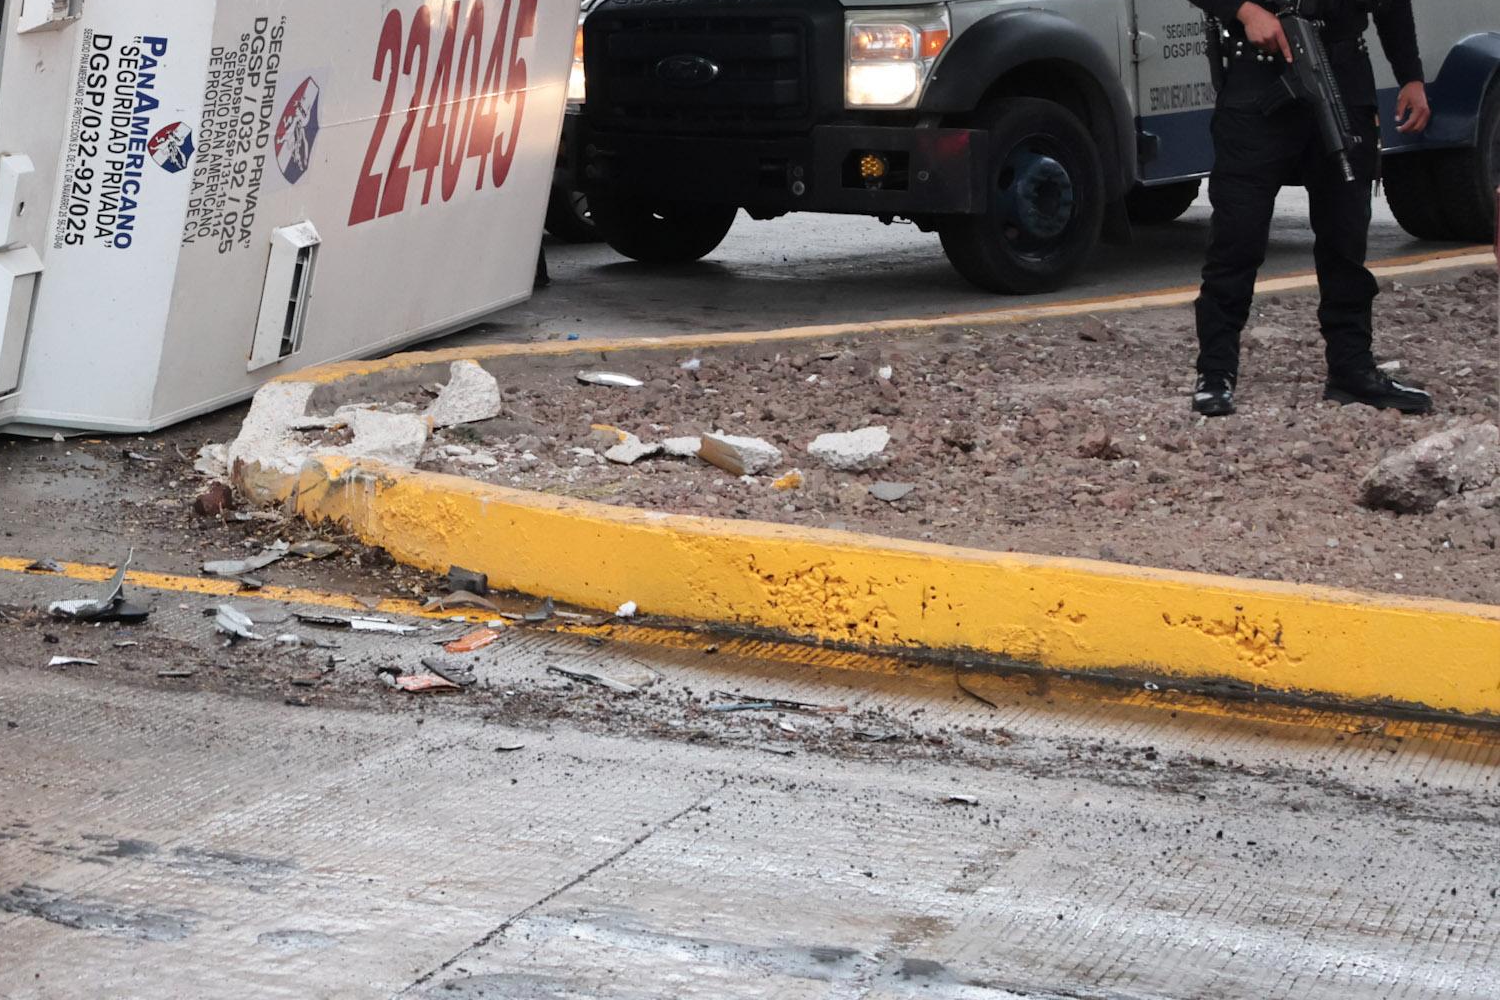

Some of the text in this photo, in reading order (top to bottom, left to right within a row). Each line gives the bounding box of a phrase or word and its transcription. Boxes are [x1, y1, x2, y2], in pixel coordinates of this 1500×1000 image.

[79, 53, 89, 65] PAN
[82, 28, 93, 53] SERVICIO
[247, 17, 268, 87] DGSP
[74, 97, 83, 105] DE
[64, 34, 113, 245] DGSP/032-92/025
[94, 35, 142, 248] "SEGURIDAD PRIVADA"
[181, 47, 224, 248] DE PROTECCION S.A. DE C.V.
[197, 51, 237, 238] SERVICIO PAN AMERICANO
[236, 111, 255, 154] 032
[238, 16, 287, 249] "SEGURIDAD PRIVADA"
[230, 160, 248, 189] 92
[218, 211, 238, 254] 025
